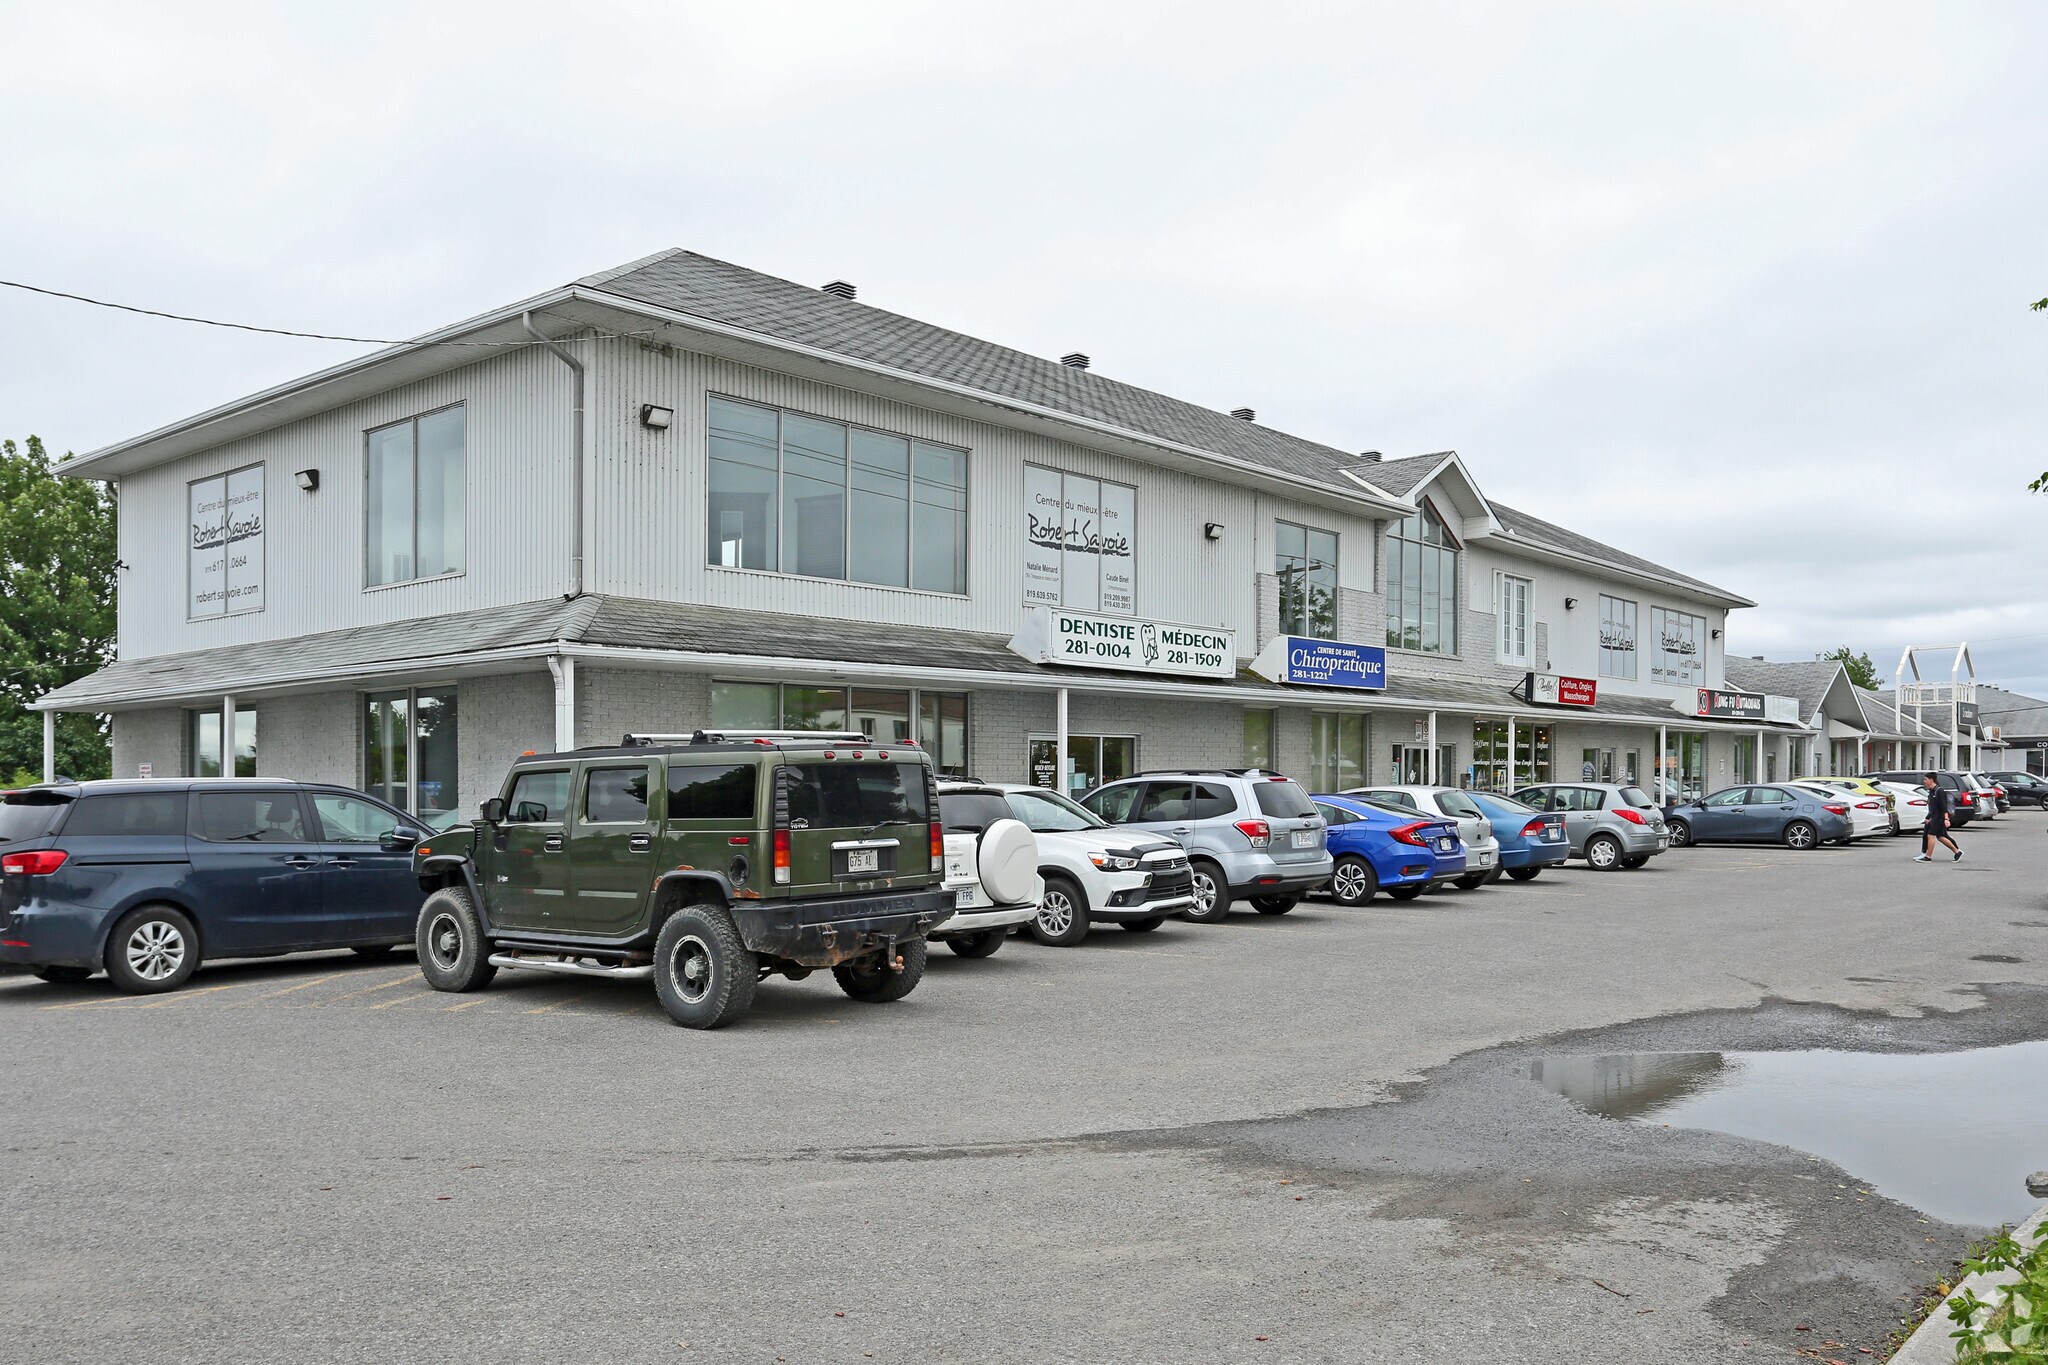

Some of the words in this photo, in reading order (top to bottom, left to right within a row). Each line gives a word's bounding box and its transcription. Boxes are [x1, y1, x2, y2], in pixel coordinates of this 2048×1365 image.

[198, 499, 216, 513] Centre
[218, 497, 225, 509] du
[1036, 493, 1060, 508] Centre
[1065, 499, 1074, 509] du
[192, 515, 225, 545] Robert
[226, 511, 261, 542] Savoie
[1028, 513, 1079, 542] Robert
[1082, 520, 1129, 551] Savoie
[1060, 618, 1135, 640] DENTISTE
[1065, 639, 1131, 658] 281-0104
[1162, 629, 1227, 650] MÉDECIN
[1167, 650, 1222, 667] 281-1509
[1317, 646, 1334, 655] CENTRE
[1335, 648, 1342, 656] DE
[1343, 649, 1357, 658] SANTÉ
[1291, 648, 1381, 679] Chiropratique
[1292, 669, 1328, 680] 281-1221
[832, 898, 915, 918] HUMMER
